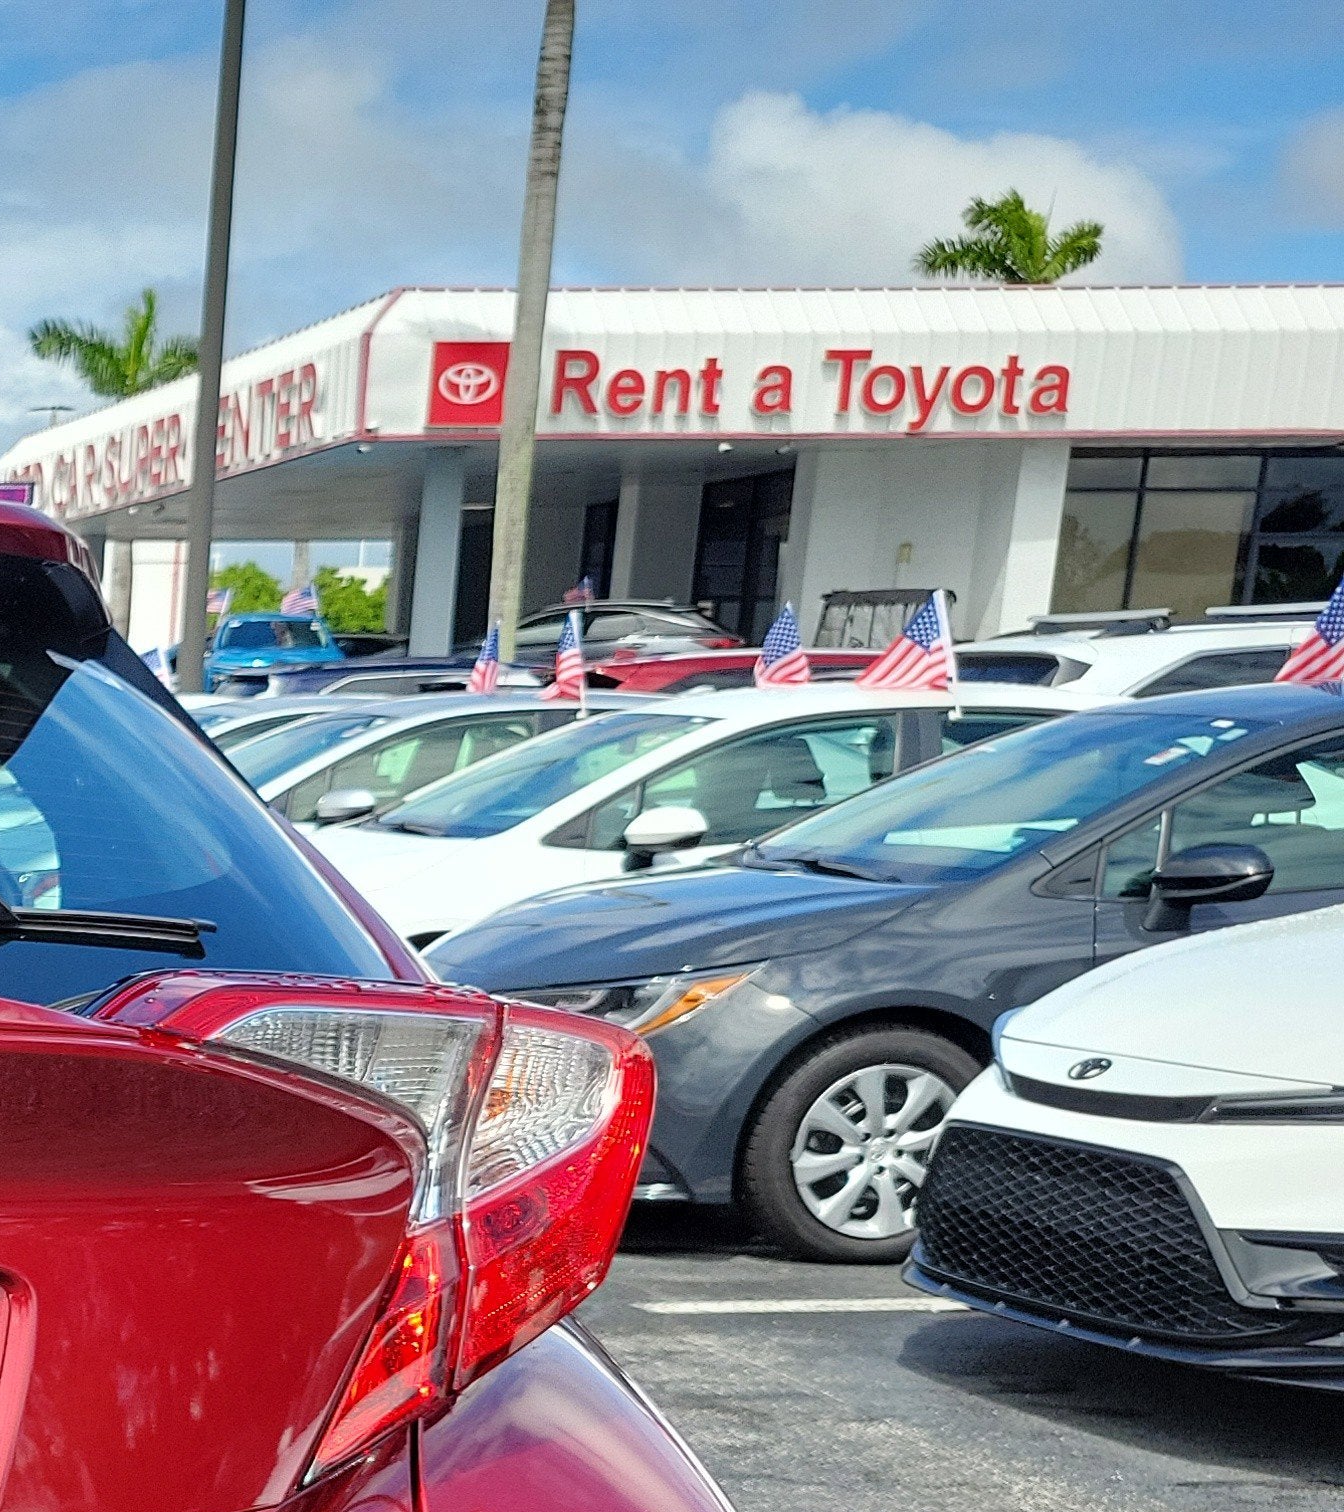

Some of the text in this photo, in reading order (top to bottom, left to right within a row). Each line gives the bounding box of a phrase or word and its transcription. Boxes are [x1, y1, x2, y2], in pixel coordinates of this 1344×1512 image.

[105, 413, 183, 497] SUPER
[216, 362, 318, 469] ENTER
[550, 348, 1072, 431] Rent a Toyota
